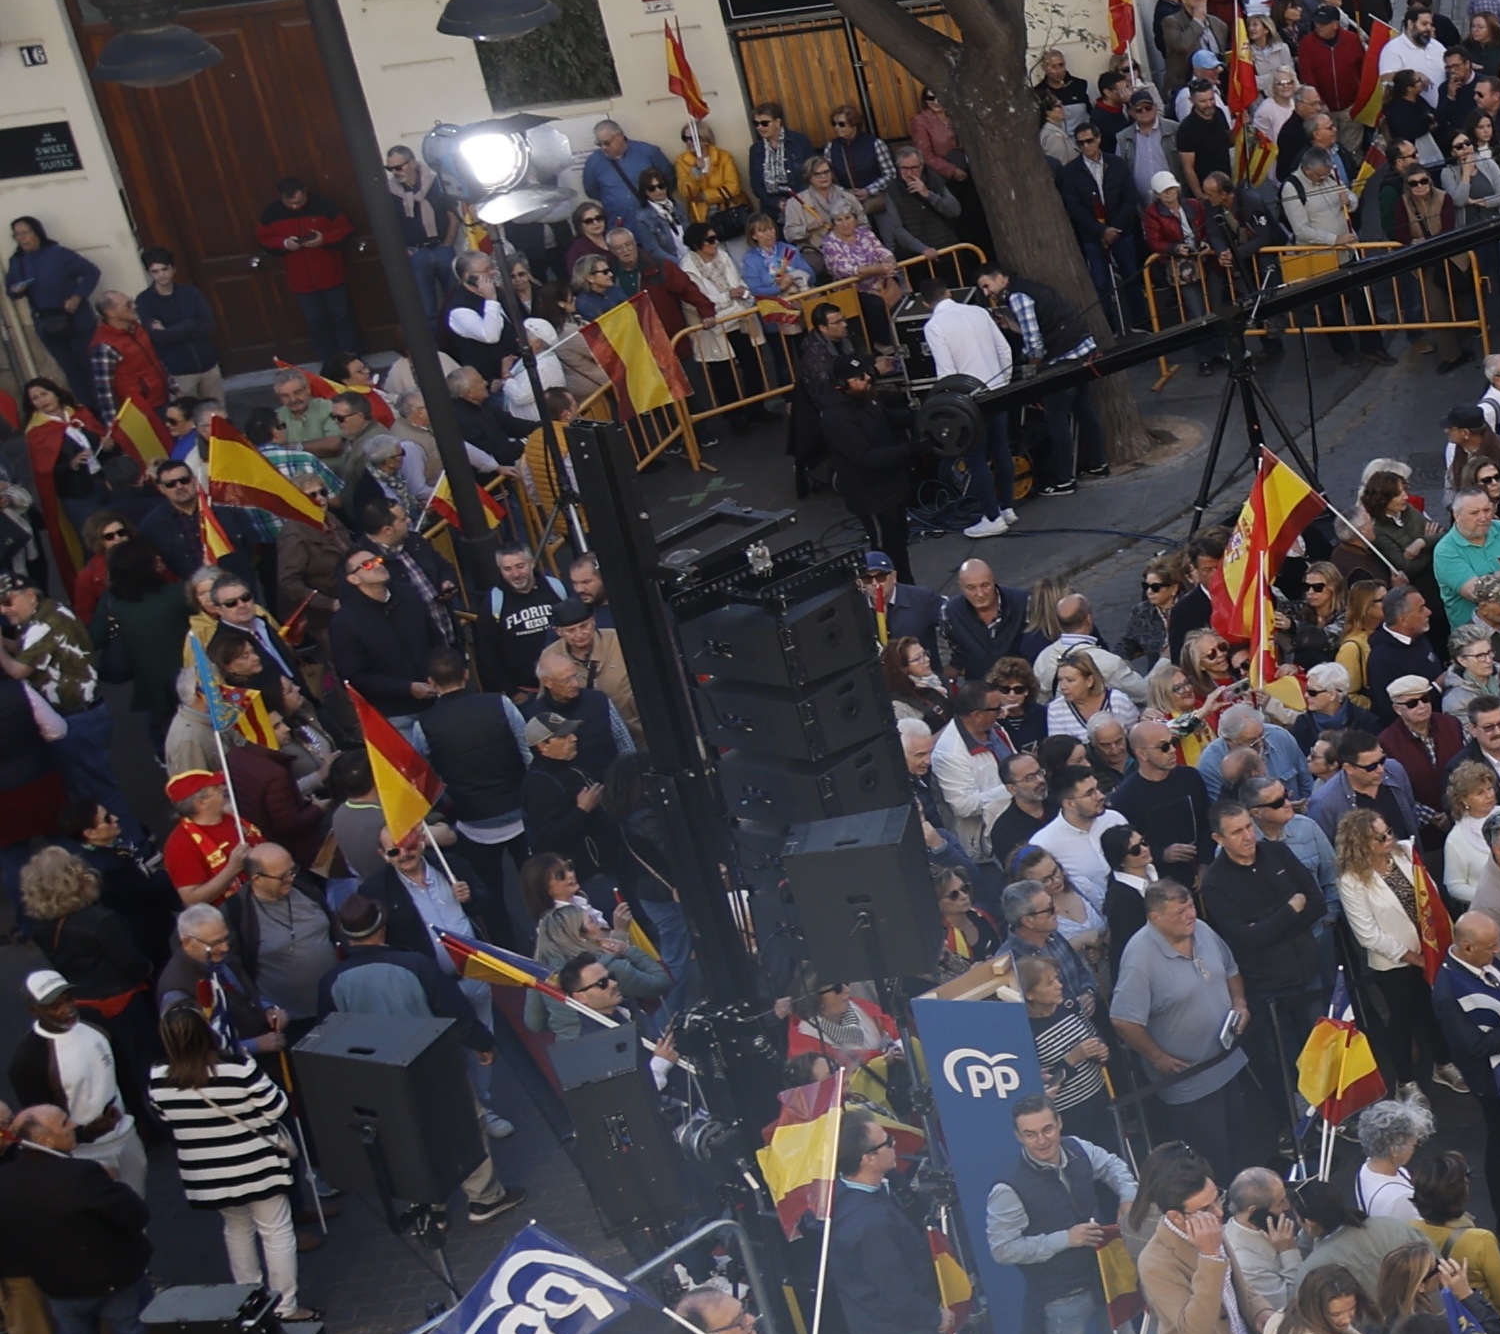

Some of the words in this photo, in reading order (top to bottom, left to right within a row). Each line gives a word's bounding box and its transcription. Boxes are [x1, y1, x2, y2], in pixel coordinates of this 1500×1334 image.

[21, 47, 46, 67] 16
[34, 143, 68, 156] SWEET
[506, 604, 553, 630] FLORID
